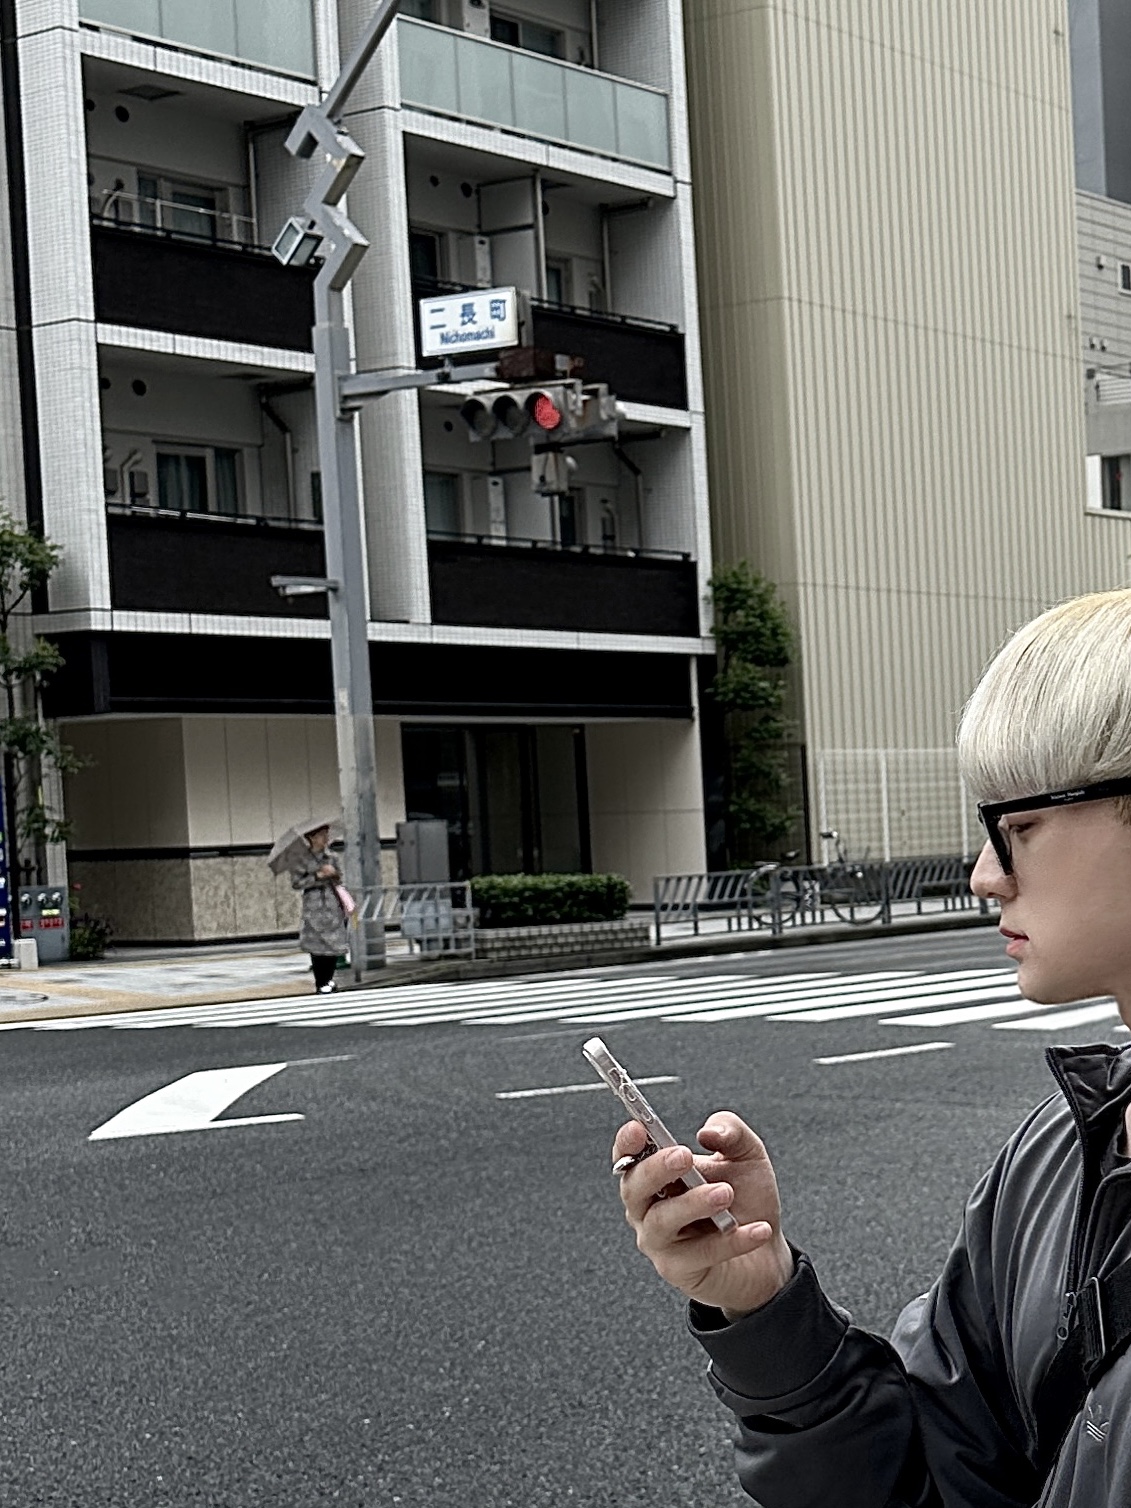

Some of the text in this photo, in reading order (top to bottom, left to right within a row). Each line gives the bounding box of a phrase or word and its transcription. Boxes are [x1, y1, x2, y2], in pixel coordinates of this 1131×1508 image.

[430, 299, 507, 330] 二長町
[440, 326, 496, 345] Nichomachi
